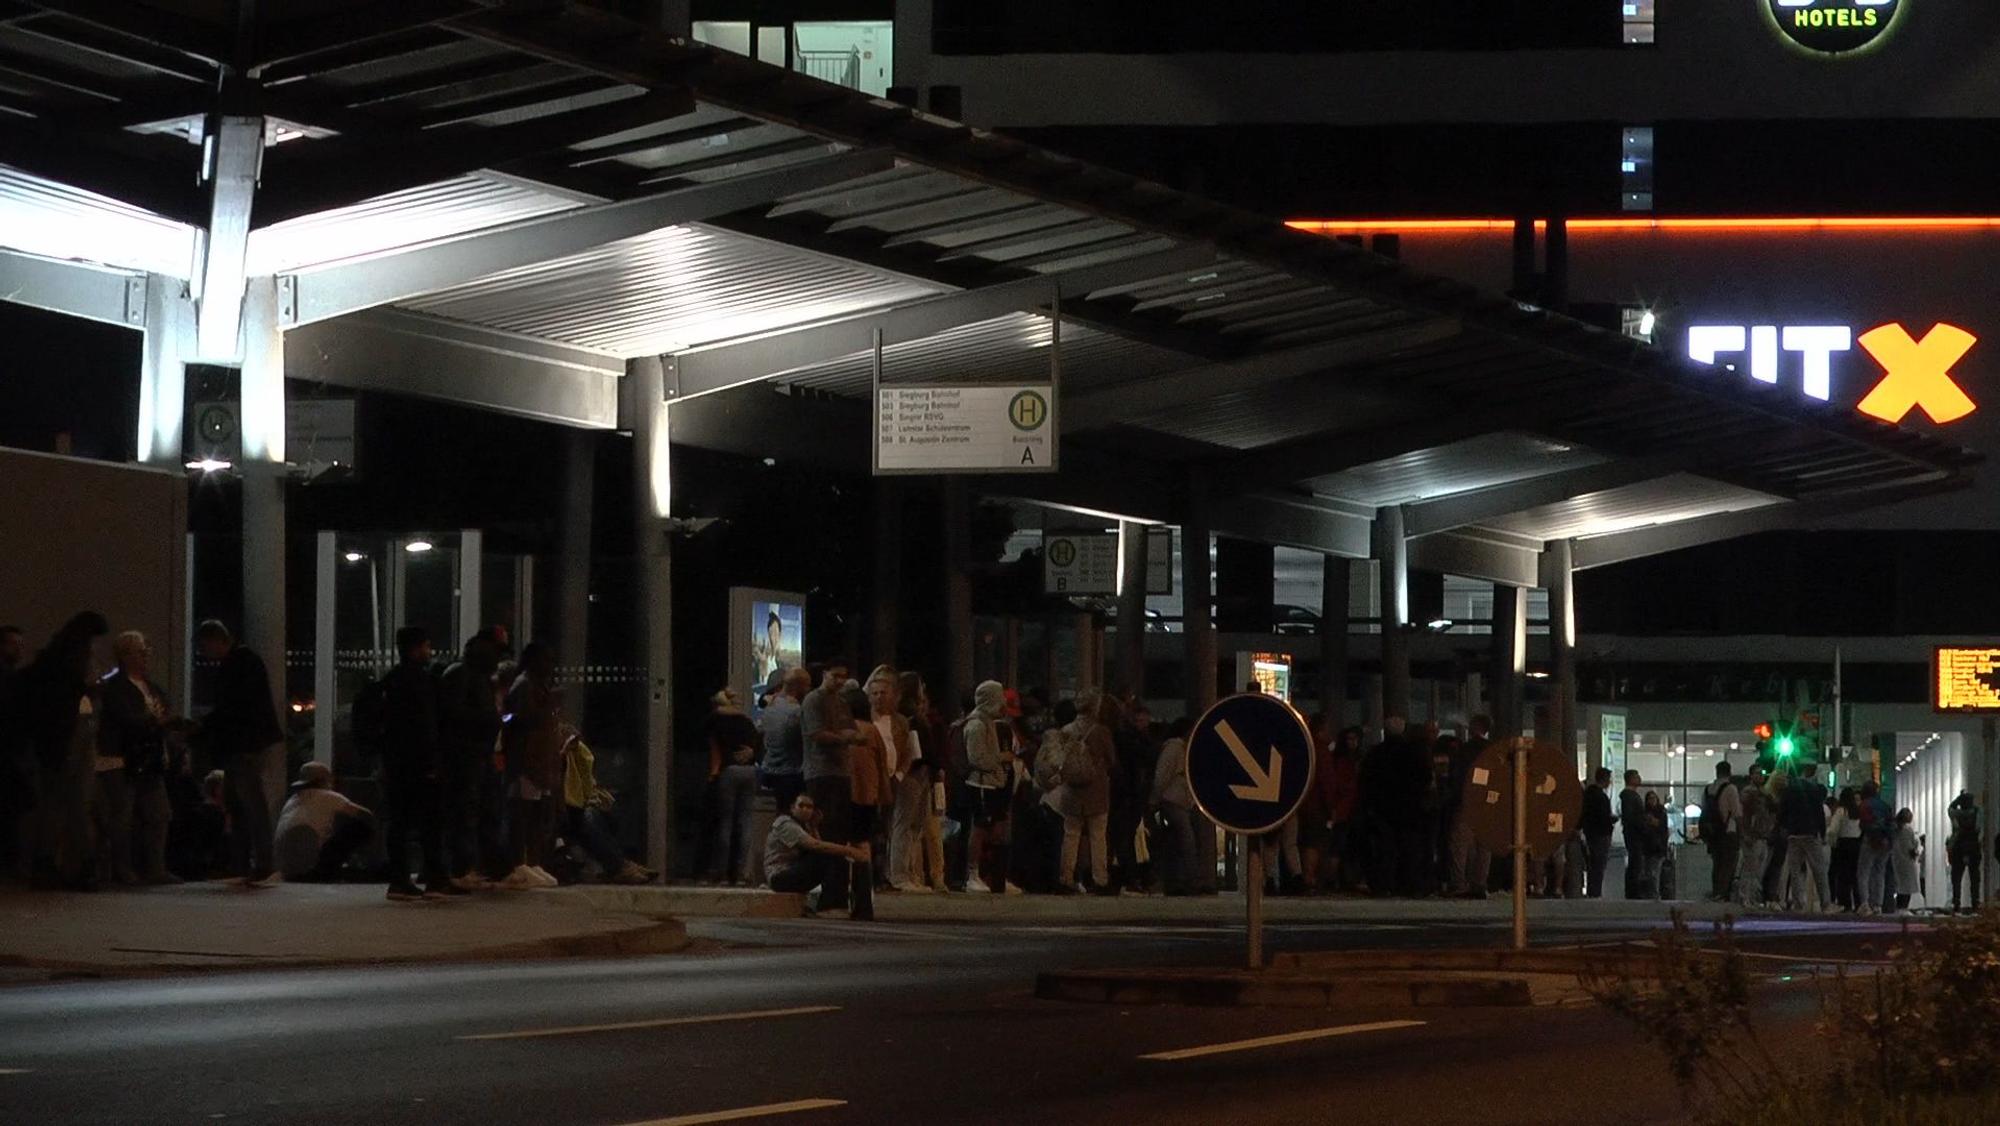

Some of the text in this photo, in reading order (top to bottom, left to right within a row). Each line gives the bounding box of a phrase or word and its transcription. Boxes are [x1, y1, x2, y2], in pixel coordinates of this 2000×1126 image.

[1795, 8, 1877, 26] HOTELS
[899, 391, 930, 400] Siegburg
[899, 402, 930, 411] Siegburg
[1020, 399, 1036, 422] H
[1021, 446, 1034, 464] A
[1056, 544, 1068, 560] H
[1057, 577, 1067, 590] B
